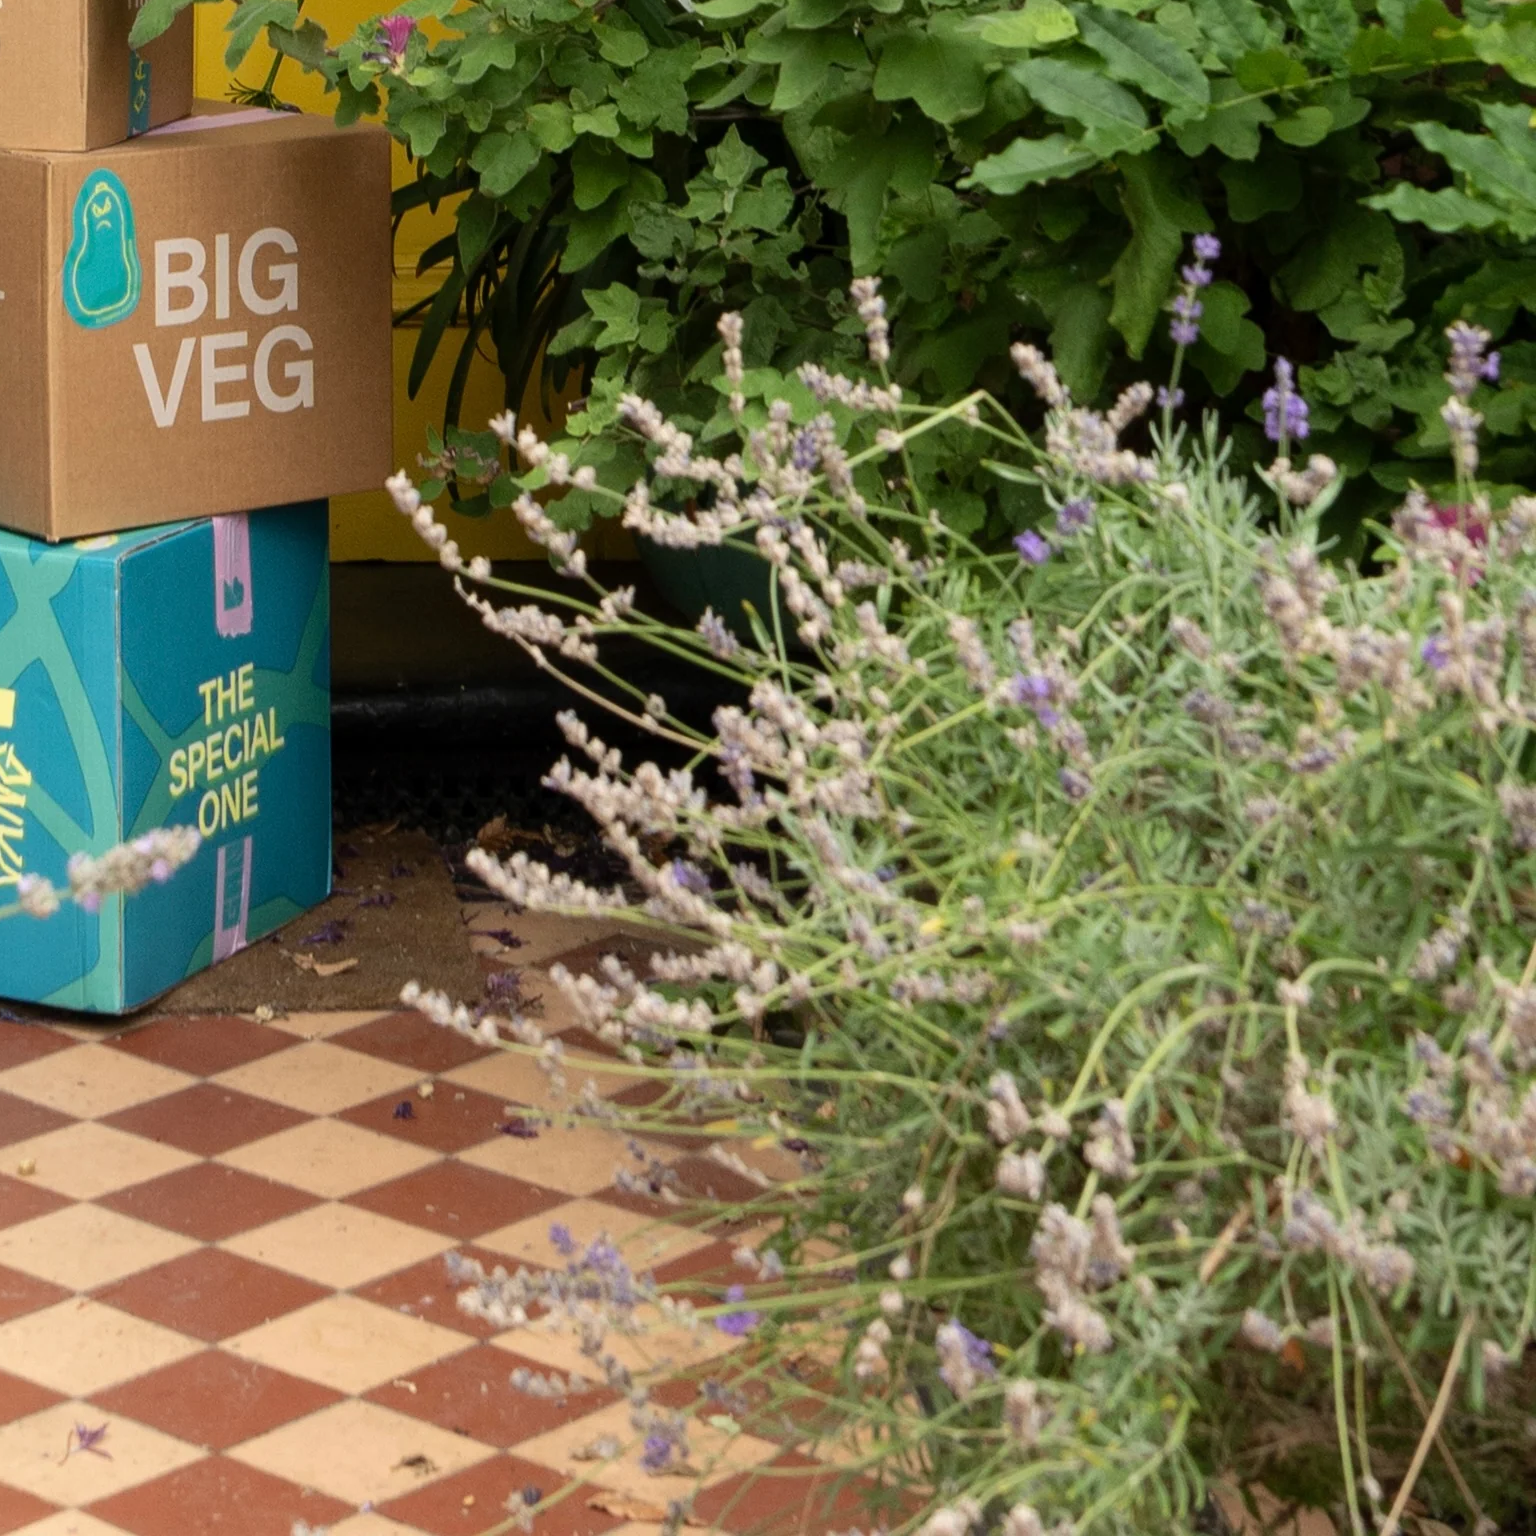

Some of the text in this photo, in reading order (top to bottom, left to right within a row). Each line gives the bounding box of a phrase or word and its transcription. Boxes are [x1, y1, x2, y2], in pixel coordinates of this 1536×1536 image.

[154, 227, 299, 328] BIG
[132, 325, 315, 429] VEG
[198, 662, 256, 727] THE
[168, 706, 286, 798] SPECIAL
[198, 768, 259, 837] ONE
